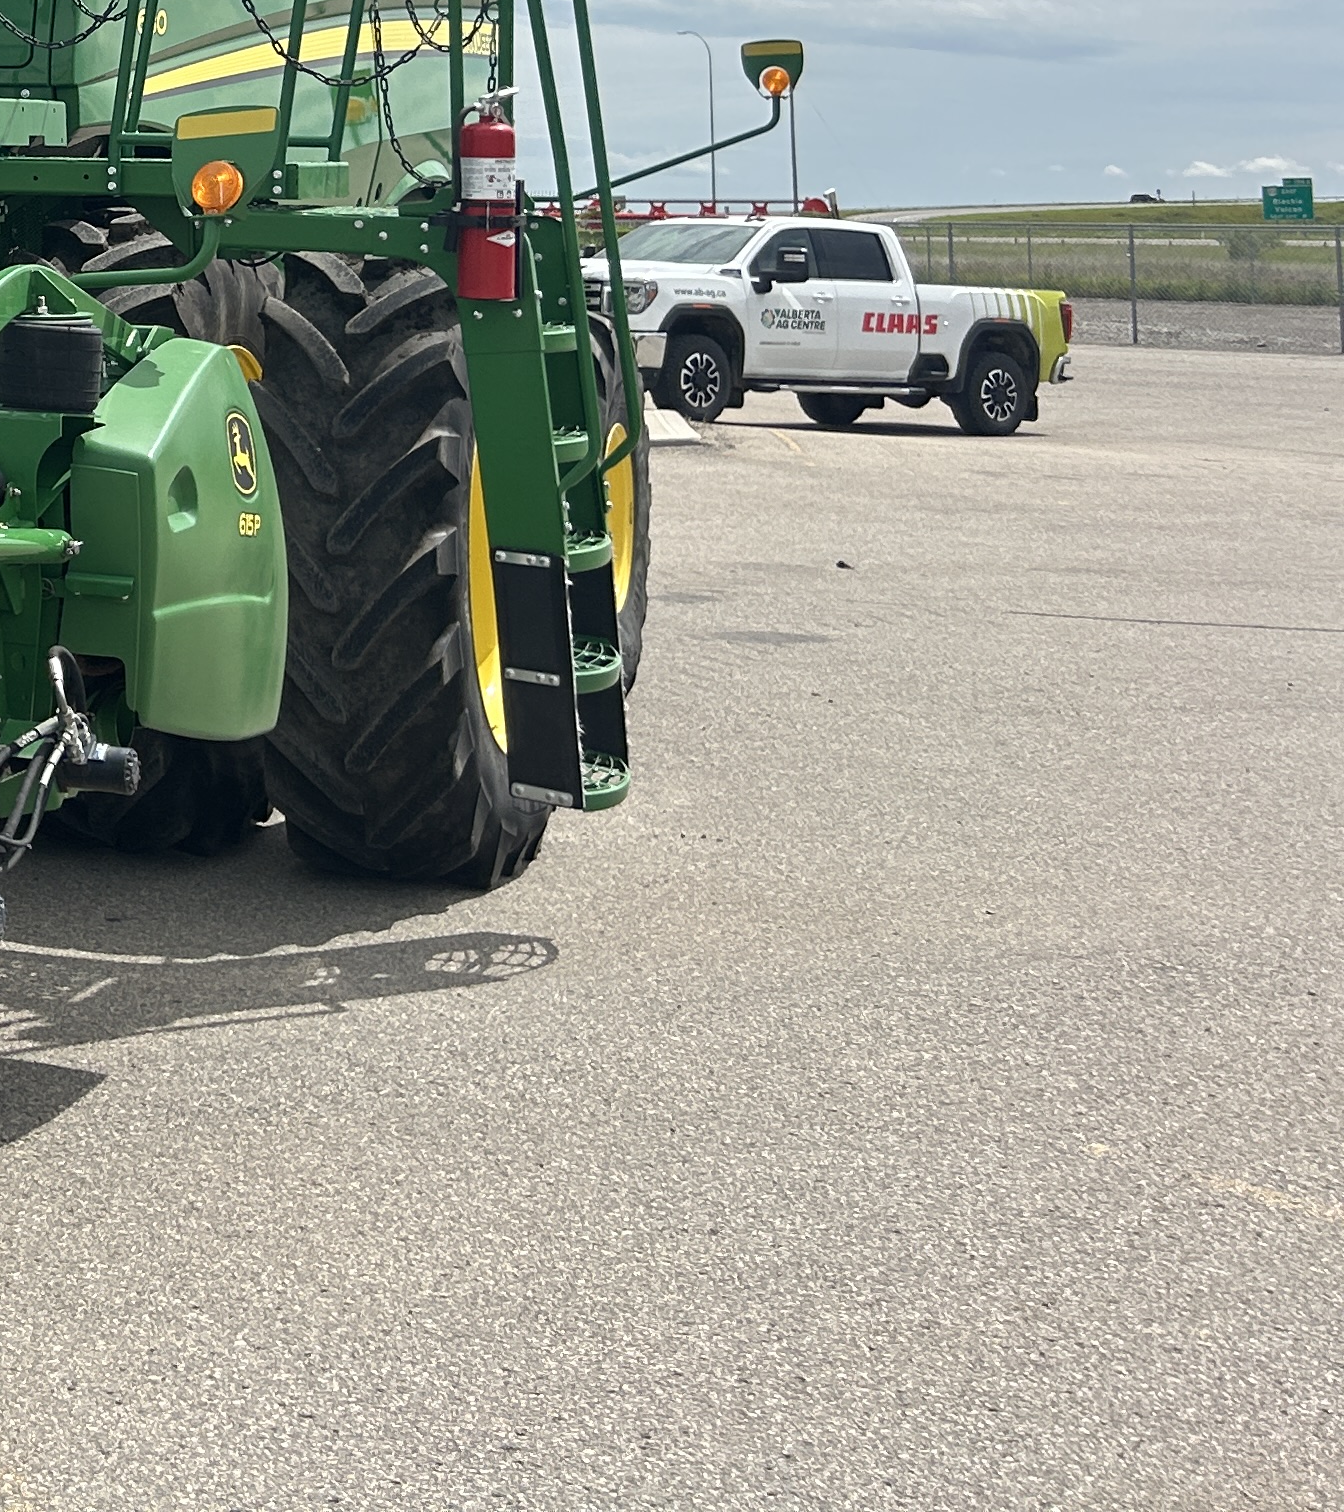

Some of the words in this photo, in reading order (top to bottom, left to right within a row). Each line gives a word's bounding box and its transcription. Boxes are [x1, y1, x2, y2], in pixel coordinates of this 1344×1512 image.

[780, 308, 821, 320] ALBERTA
[775, 319, 789, 329] AG
[791, 320, 826, 331] CENTRE
[862, 312, 938, 335] CLAAS
[239, 511, 261, 537] 615P
